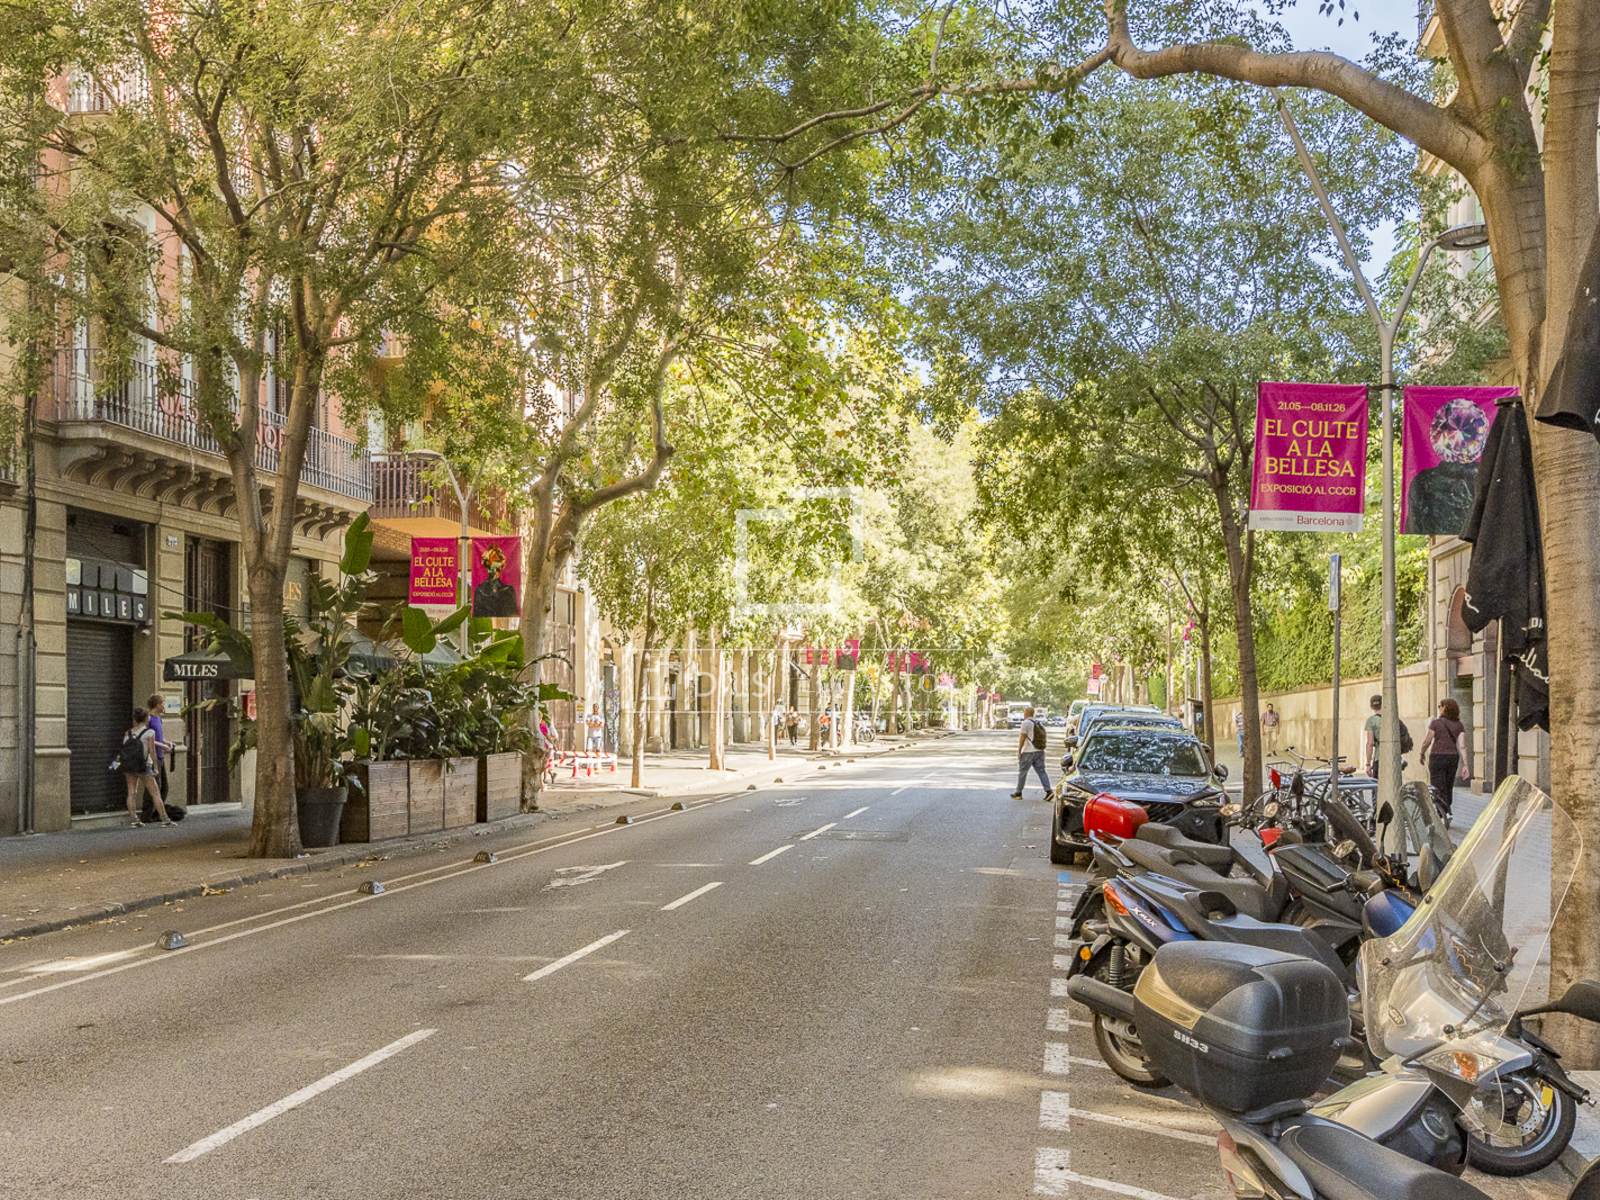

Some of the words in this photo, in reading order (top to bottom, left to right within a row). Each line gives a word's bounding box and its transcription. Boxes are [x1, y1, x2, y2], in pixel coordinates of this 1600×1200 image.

[1264, 418, 1289, 437] EL
[1292, 419, 1359, 439] CULTE
[1286, 439, 1302, 457] A
[1307, 439, 1334, 458] LA
[1265, 456, 1357, 478] BELLESA
[1260, 483, 1313, 496] EXPOSICIÓ
[1314, 487, 1326, 496] AL
[1328, 486, 1357, 496] CCCB
[1296, 515, 1345, 526] Barcelona
[414, 557, 424, 566] EL
[425, 556, 455, 567] CULTE
[423, 567, 431, 577] A
[432, 567, 444, 577] LA
[414, 577, 454, 588] BELLESA
[68, 592, 145, 619] MILES
[174, 664, 219, 677] MILES
